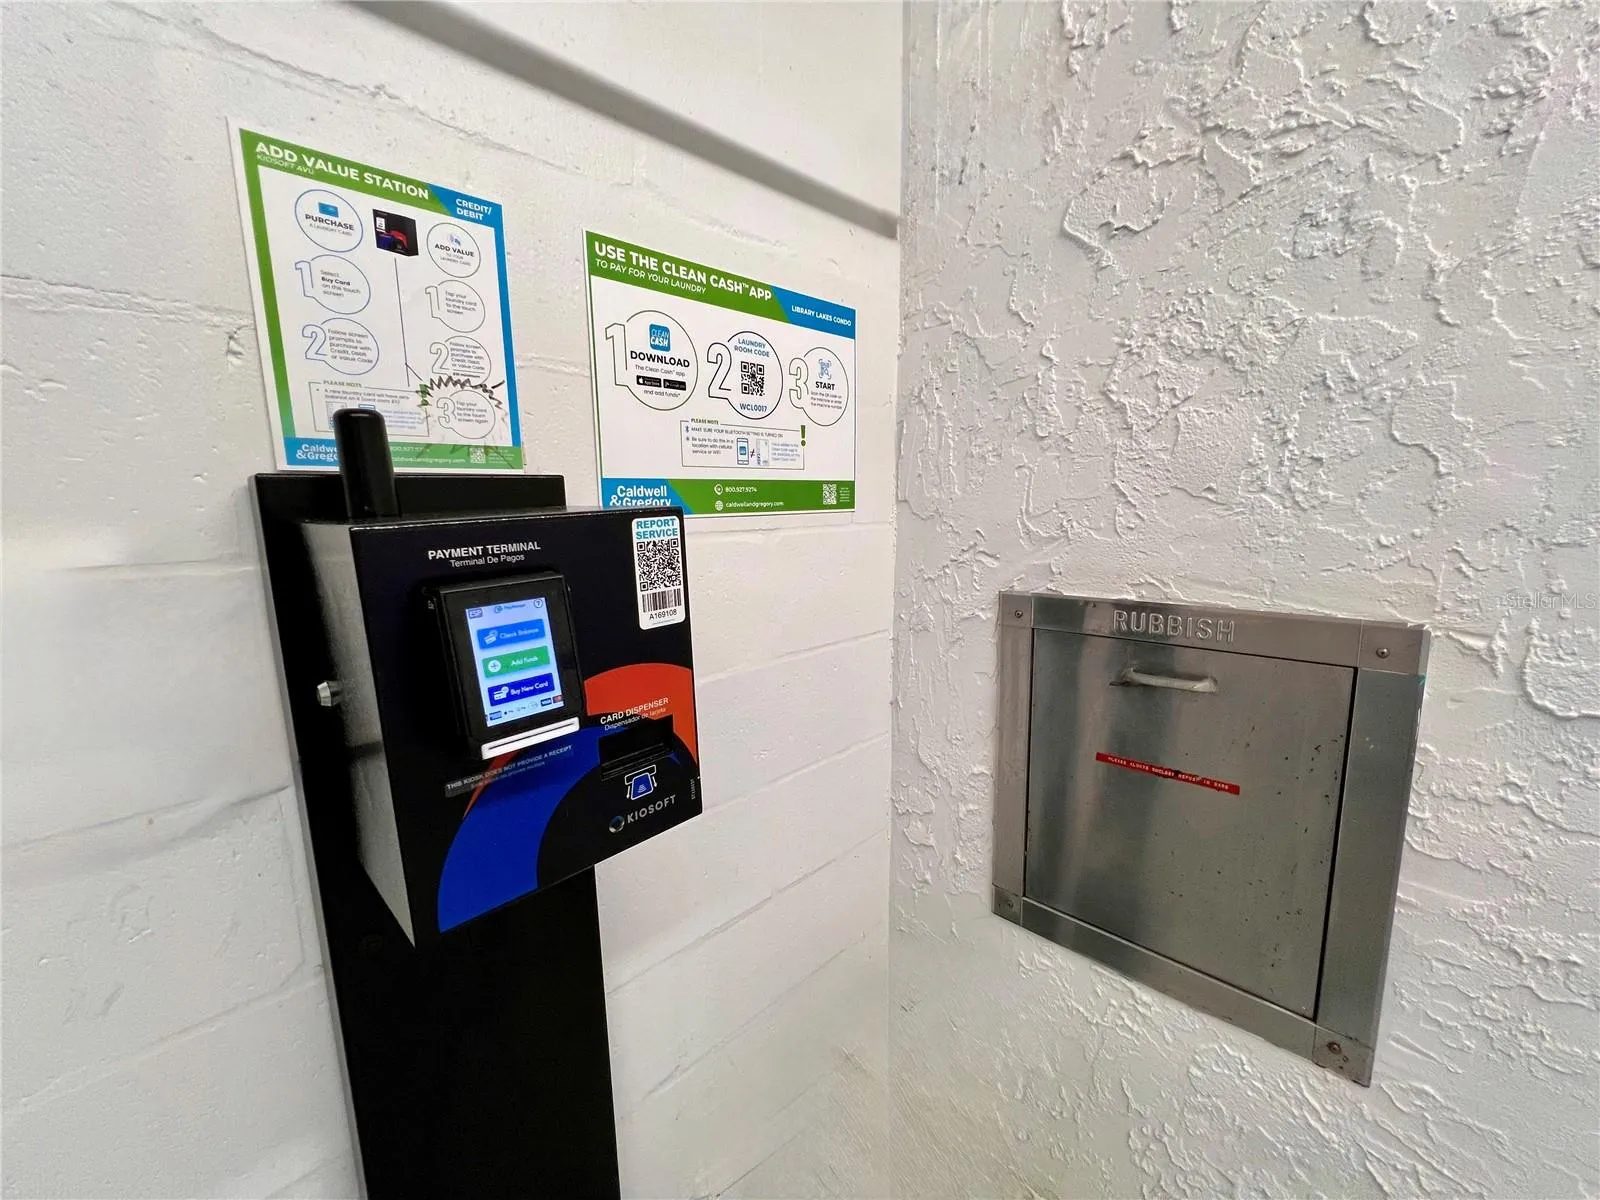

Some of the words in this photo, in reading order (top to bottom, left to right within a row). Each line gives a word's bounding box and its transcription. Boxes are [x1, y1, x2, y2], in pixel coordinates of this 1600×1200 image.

[257, 154, 295, 169] KIOSOFT
[256, 142, 298, 162] ADD
[302, 153, 359, 181] VALUE
[363, 172, 429, 200] STATION
[456, 199, 492, 215] CREDIT/
[456, 207, 483, 220] DEBIT
[305, 214, 355, 231] PURCHASE
[435, 243, 450, 251] ADD
[452, 248, 474, 257] VALUE
[595, 241, 626, 262] USE
[629, 251, 659, 271] THE
[662, 261, 707, 284] CLEAN
[749, 286, 772, 301] APP
[596, 258, 608, 269] TO
[610, 263, 627, 273] PAY
[628, 267, 646, 279] FOR
[647, 272, 669, 285] YOUR
[671, 280, 706, 294] LAUNDRY
[792, 305, 815, 316] LIBRARY
[815, 311, 833, 322] LAKES
[833, 316, 852, 326] CONDO
[651, 328, 669, 338] CLEAN
[650, 337, 669, 347] CASH
[738, 338, 766, 349] LAUNDRY
[630, 350, 690, 368] DOWNLOAD
[734, 346, 753, 355] ROOM
[754, 349, 770, 358] CODE
[815, 381, 835, 391] START
[740, 403, 767, 412] WCL0017
[296, 449, 337, 461] &Greg
[302, 444, 337, 452] Caldw
[617, 485, 667, 497] Caldwell
[636, 519, 676, 529] REPORT
[636, 528, 678, 539] SERVICE
[428, 546, 484, 560] PAYMENT
[486, 541, 541, 554] TERMINAL
[450, 557, 485, 568] Terminal
[487, 556, 498, 564] De
[500, 554, 525, 563] Pagos
[649, 608, 678, 620] A169108
[1113, 609, 1235, 642] RUBBISH
[511, 659, 523, 667] Add
[510, 687, 521, 696] Buy
[521, 684, 534, 693] New
[534, 681, 549, 690] Card
[600, 711, 624, 725] CARD
[625, 697, 669, 717] DISPENSER
[604, 714, 640, 731] Dispensador
[447, 781, 463, 790] THIS
[463, 774, 484, 785] KIOSK
[485, 767, 502, 778] DOES
[503, 763, 516, 772] NOT
[517, 755, 542, 767] PROVIDE
[549, 745, 572, 757] RECEIPT
[627, 795, 676, 823] KIOSOFT
